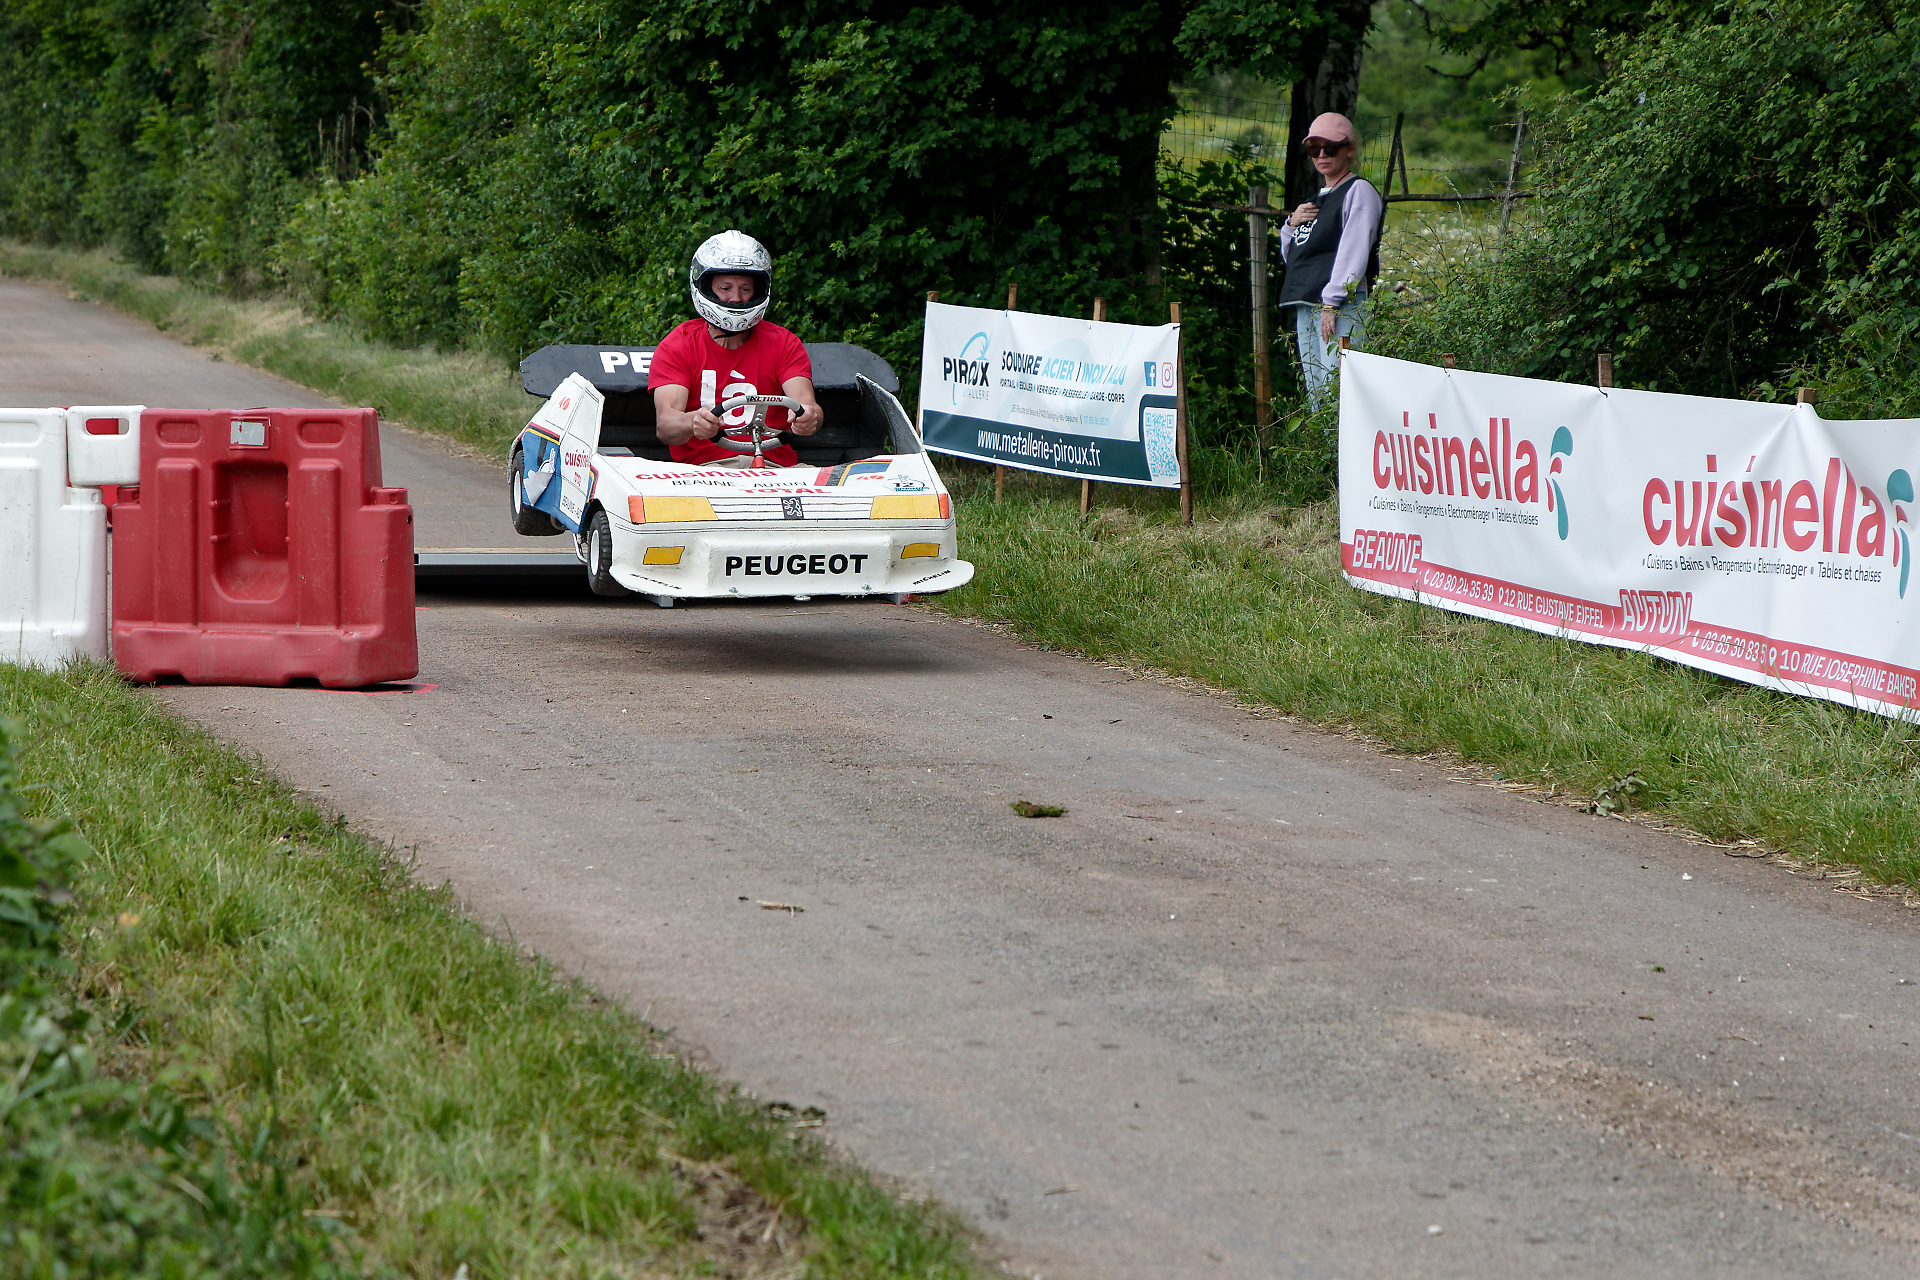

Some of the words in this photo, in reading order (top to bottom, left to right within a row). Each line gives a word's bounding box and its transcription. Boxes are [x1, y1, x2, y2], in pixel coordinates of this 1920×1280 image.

[599, 351, 655, 374] PE
[1001, 350, 1042, 376] SOUDURE
[1041, 357, 1075, 381] ACIER
[1081, 362, 1108, 384] INOX
[1107, 365, 1128, 386] ALU
[977, 429, 1101, 467] www.metallerie-piroux.fr
[1373, 411, 1539, 504] cuisinella
[635, 470, 778, 480] cuisinella
[1373, 496, 1397, 511] Cuisines
[1400, 499, 1413, 513] Bains
[1415, 500, 1445, 519] Rangements
[1447, 504, 1491, 523] Electroménager
[1495, 507, 1512, 523] Tables
[1512, 511, 1518, 523] et
[1517, 509, 1539, 526] chaises
[1643, 454, 1887, 558] cuisinella
[725, 553, 869, 577] PEUGEOT
[1352, 534, 1422, 574] BEAUNE
[1646, 554, 1673, 570] Cuisines
[1679, 555, 1705, 571] Bains
[1711, 556, 1752, 576] Rangements
[1817, 561, 1843, 580] Tables
[1843, 565, 1853, 581] et
[1854, 566, 1882, 583] chaises
[1430, 571, 1443, 588] 03
[1443, 574, 1457, 592] 80
[1458, 577, 1470, 596] 24
[1469, 580, 1481, 598] 35
[1482, 583, 1494, 601] 39
[1505, 588, 1516, 607] 12
[1516, 591, 1534, 613] RUE
[1535, 595, 1575, 622] GUSTAVE
[1576, 604, 1605, 629] EIFFEL
[1620, 593, 1691, 636] AUTUN
[1700, 631, 1716, 652] 03
[1715, 634, 1732, 656] 85
[1730, 637, 1746, 659] 30
[1746, 640, 1760, 662] 83
[1779, 648, 1801, 672] 10
[1800, 652, 1824, 677] RUE
[1822, 658, 1889, 692] JOSEPHINE
[1886, 671, 1917, 700] BAKER
